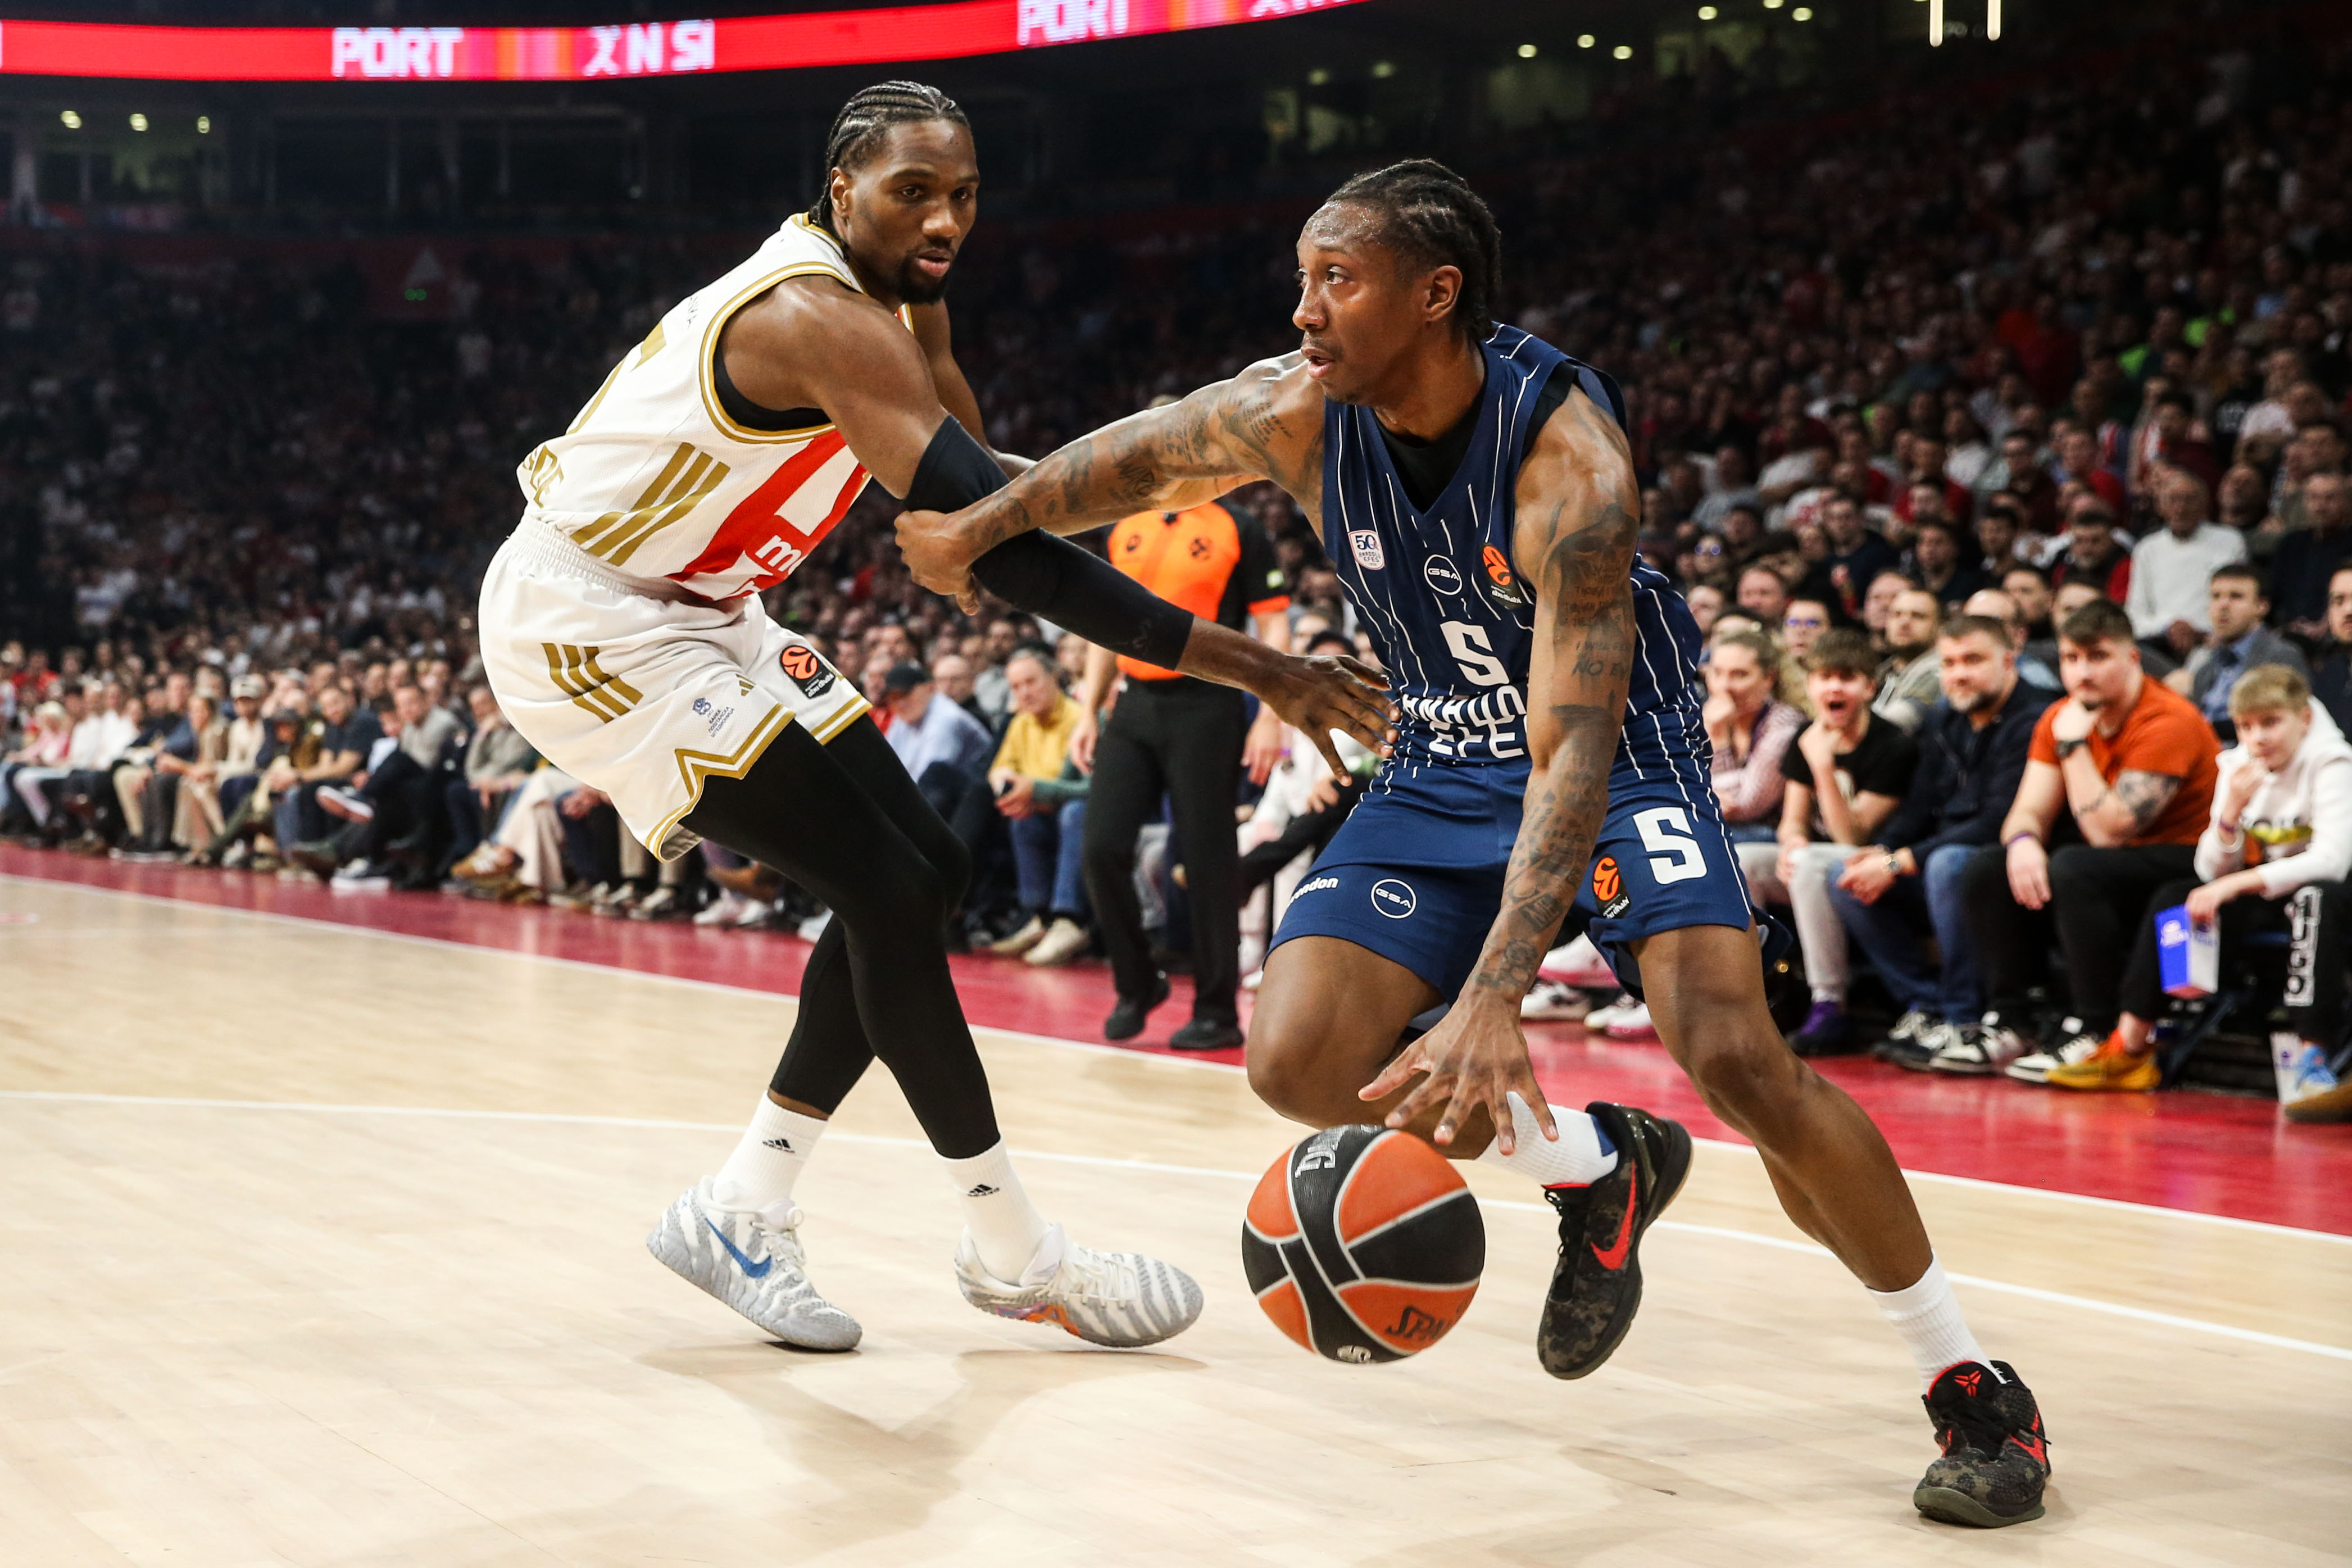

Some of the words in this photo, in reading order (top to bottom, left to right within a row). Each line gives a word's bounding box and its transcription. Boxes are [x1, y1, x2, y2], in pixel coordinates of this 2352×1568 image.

[332, 27, 464, 78] PORT
[1427, 567, 1459, 581] GSA
[1428, 720, 1528, 759] EFE
[1633, 807, 1707, 884] 5
[1375, 888, 1411, 909] GSA
